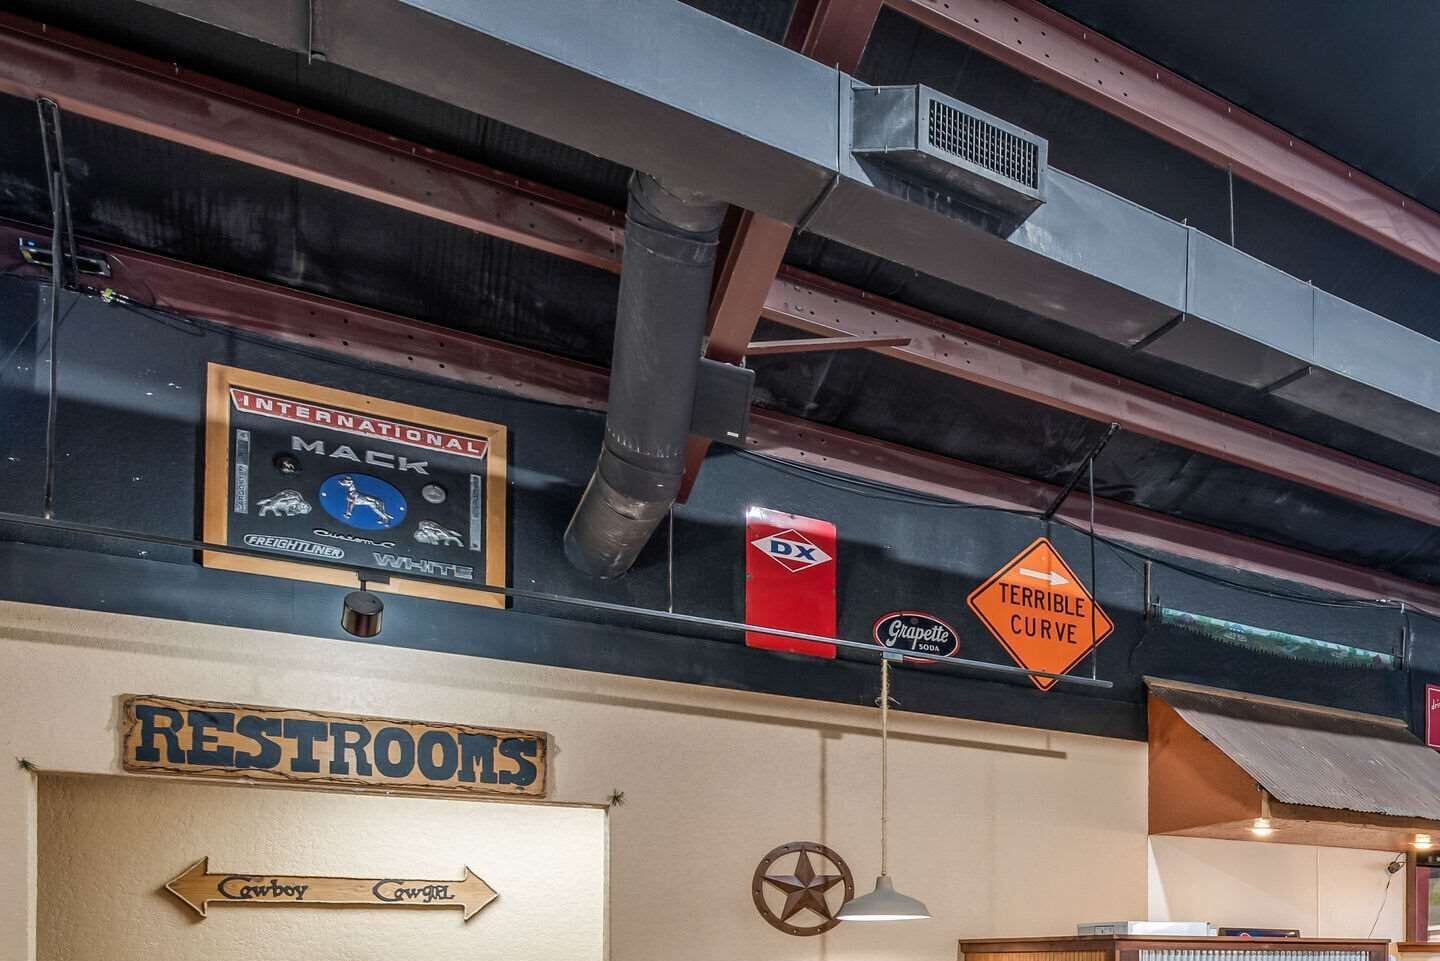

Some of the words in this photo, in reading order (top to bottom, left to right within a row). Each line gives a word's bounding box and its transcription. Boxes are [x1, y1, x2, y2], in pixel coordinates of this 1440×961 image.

[242, 394, 481, 454] INTERNATIONAL
[291, 435, 430, 476] MACK
[247, 535, 342, 559] FREIGHTLINER
[770, 539, 817, 561] DX
[373, 552, 474, 580] WHITE
[998, 581, 1087, 618] TERRIBLE
[886, 619, 950, 649] Grapette
[1010, 614, 1078, 645] CURVE
[918, 644, 940, 653] SODA
[135, 705, 538, 787] RESTROOMS
[217, 876, 309, 900] Cowboy
